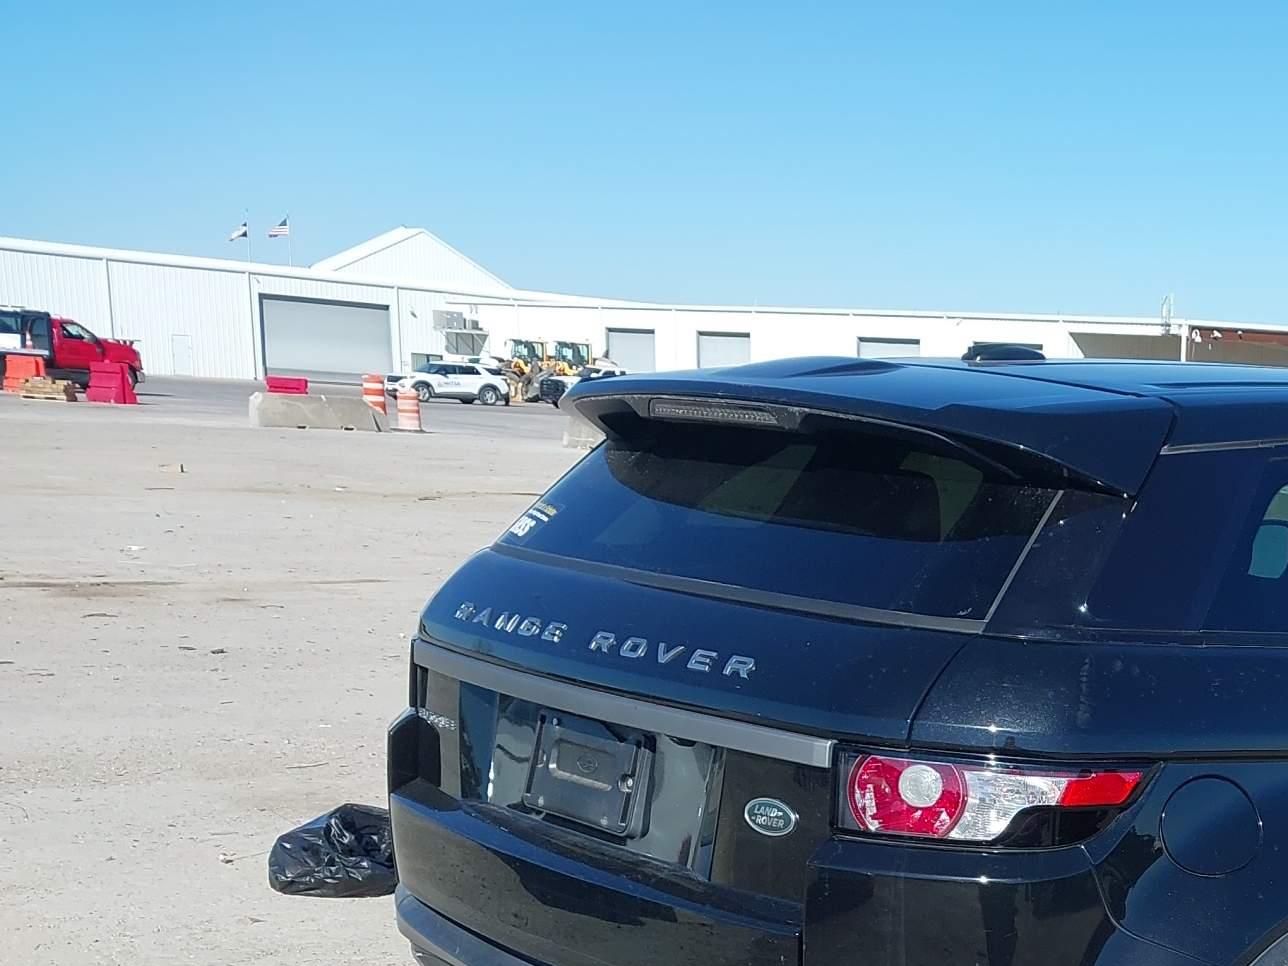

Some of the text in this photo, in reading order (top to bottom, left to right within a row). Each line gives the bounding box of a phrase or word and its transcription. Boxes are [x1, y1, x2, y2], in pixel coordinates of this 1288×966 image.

[454, 601, 757, 680] RANGE ROVER
[754, 804, 778, 817] LAND
[755, 814, 785, 829] ROVER
